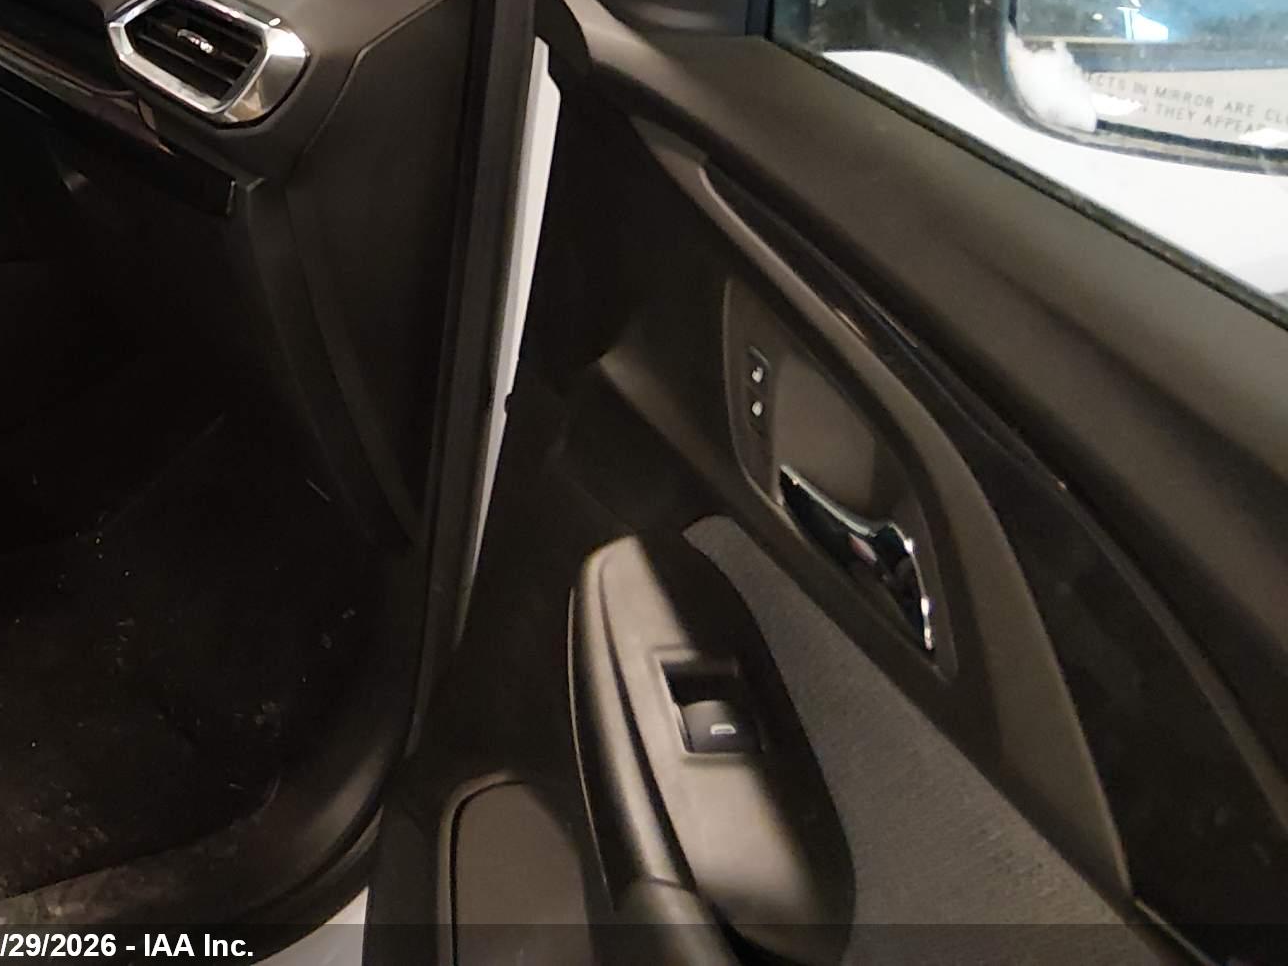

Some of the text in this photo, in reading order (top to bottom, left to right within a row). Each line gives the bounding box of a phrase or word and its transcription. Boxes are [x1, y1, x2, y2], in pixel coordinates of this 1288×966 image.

[1132, 81, 1147, 95] IN
[1153, 84, 1215, 107] MIRROR
[1222, 100, 1256, 118] ARE
[1155, 101, 1197, 122] THEY
